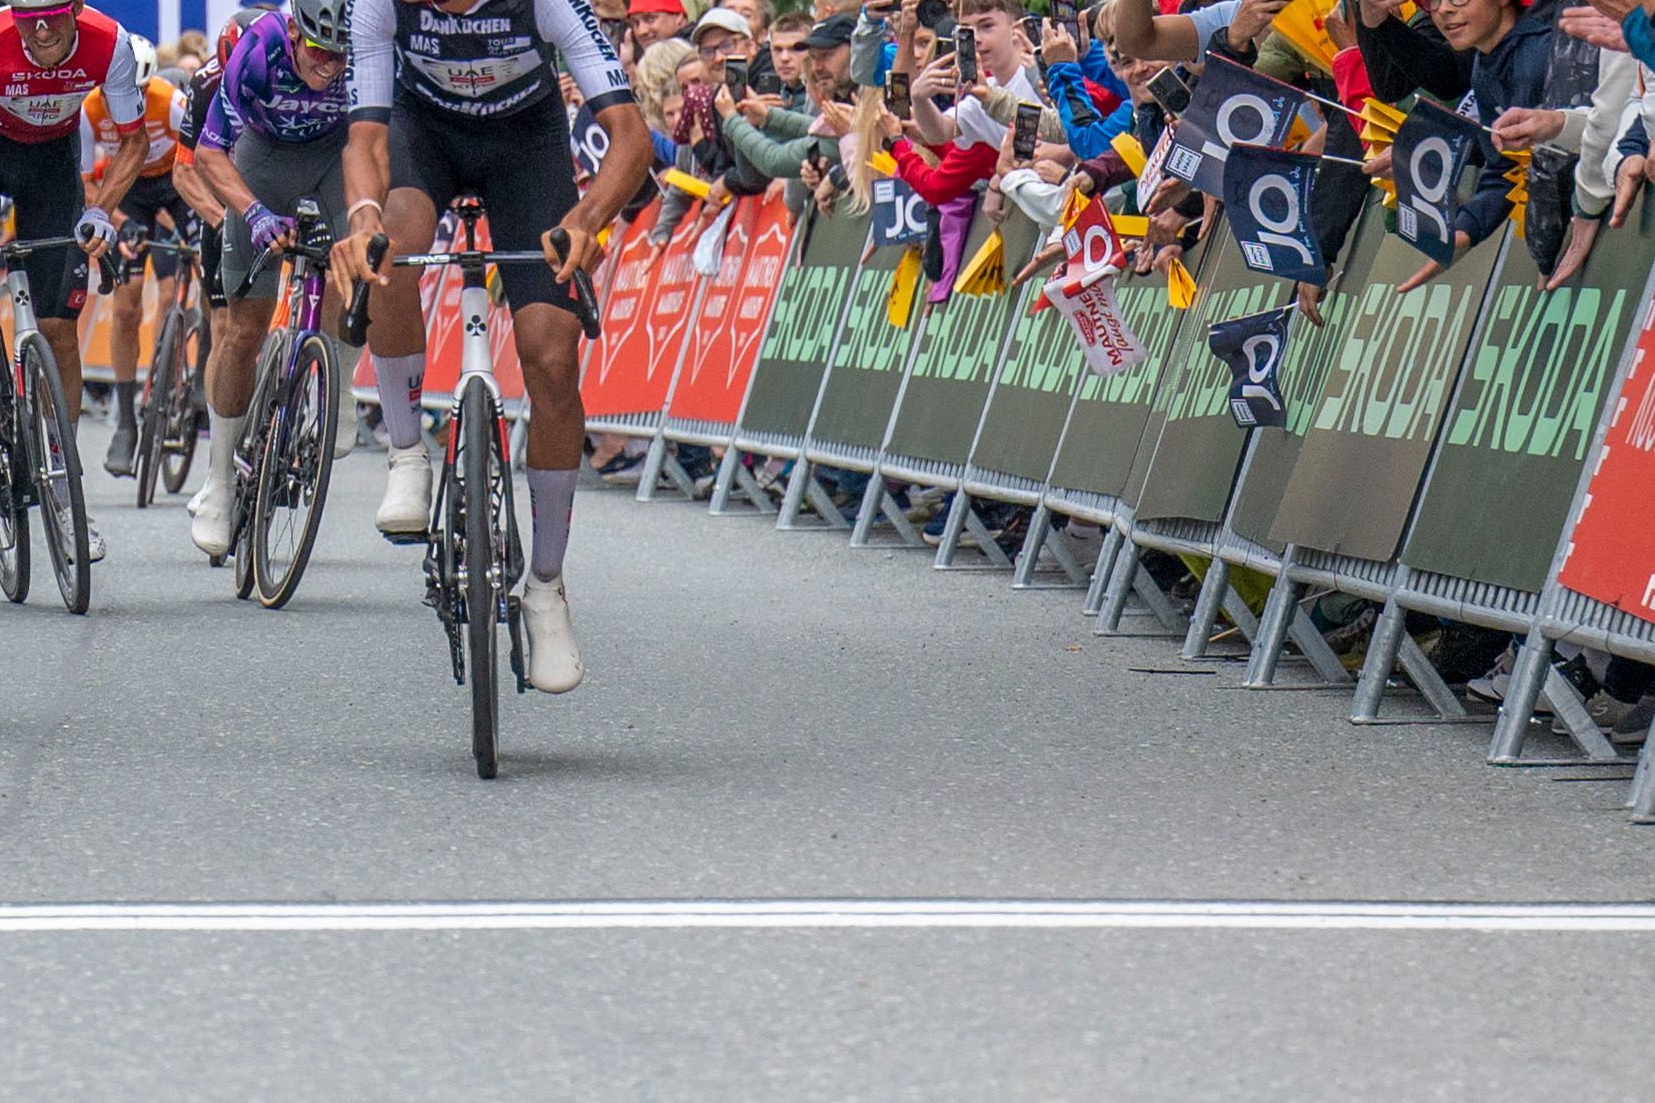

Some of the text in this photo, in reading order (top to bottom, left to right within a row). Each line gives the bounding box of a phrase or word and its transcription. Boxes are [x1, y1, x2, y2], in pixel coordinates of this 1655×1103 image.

[419, 9, 512, 36] DANKÜCHEN
[4, 83, 30, 97] MAS
[1248, 173, 1315, 267] JO
[1410, 136, 1453, 244] JO
[1242, 334, 1282, 411] JO
